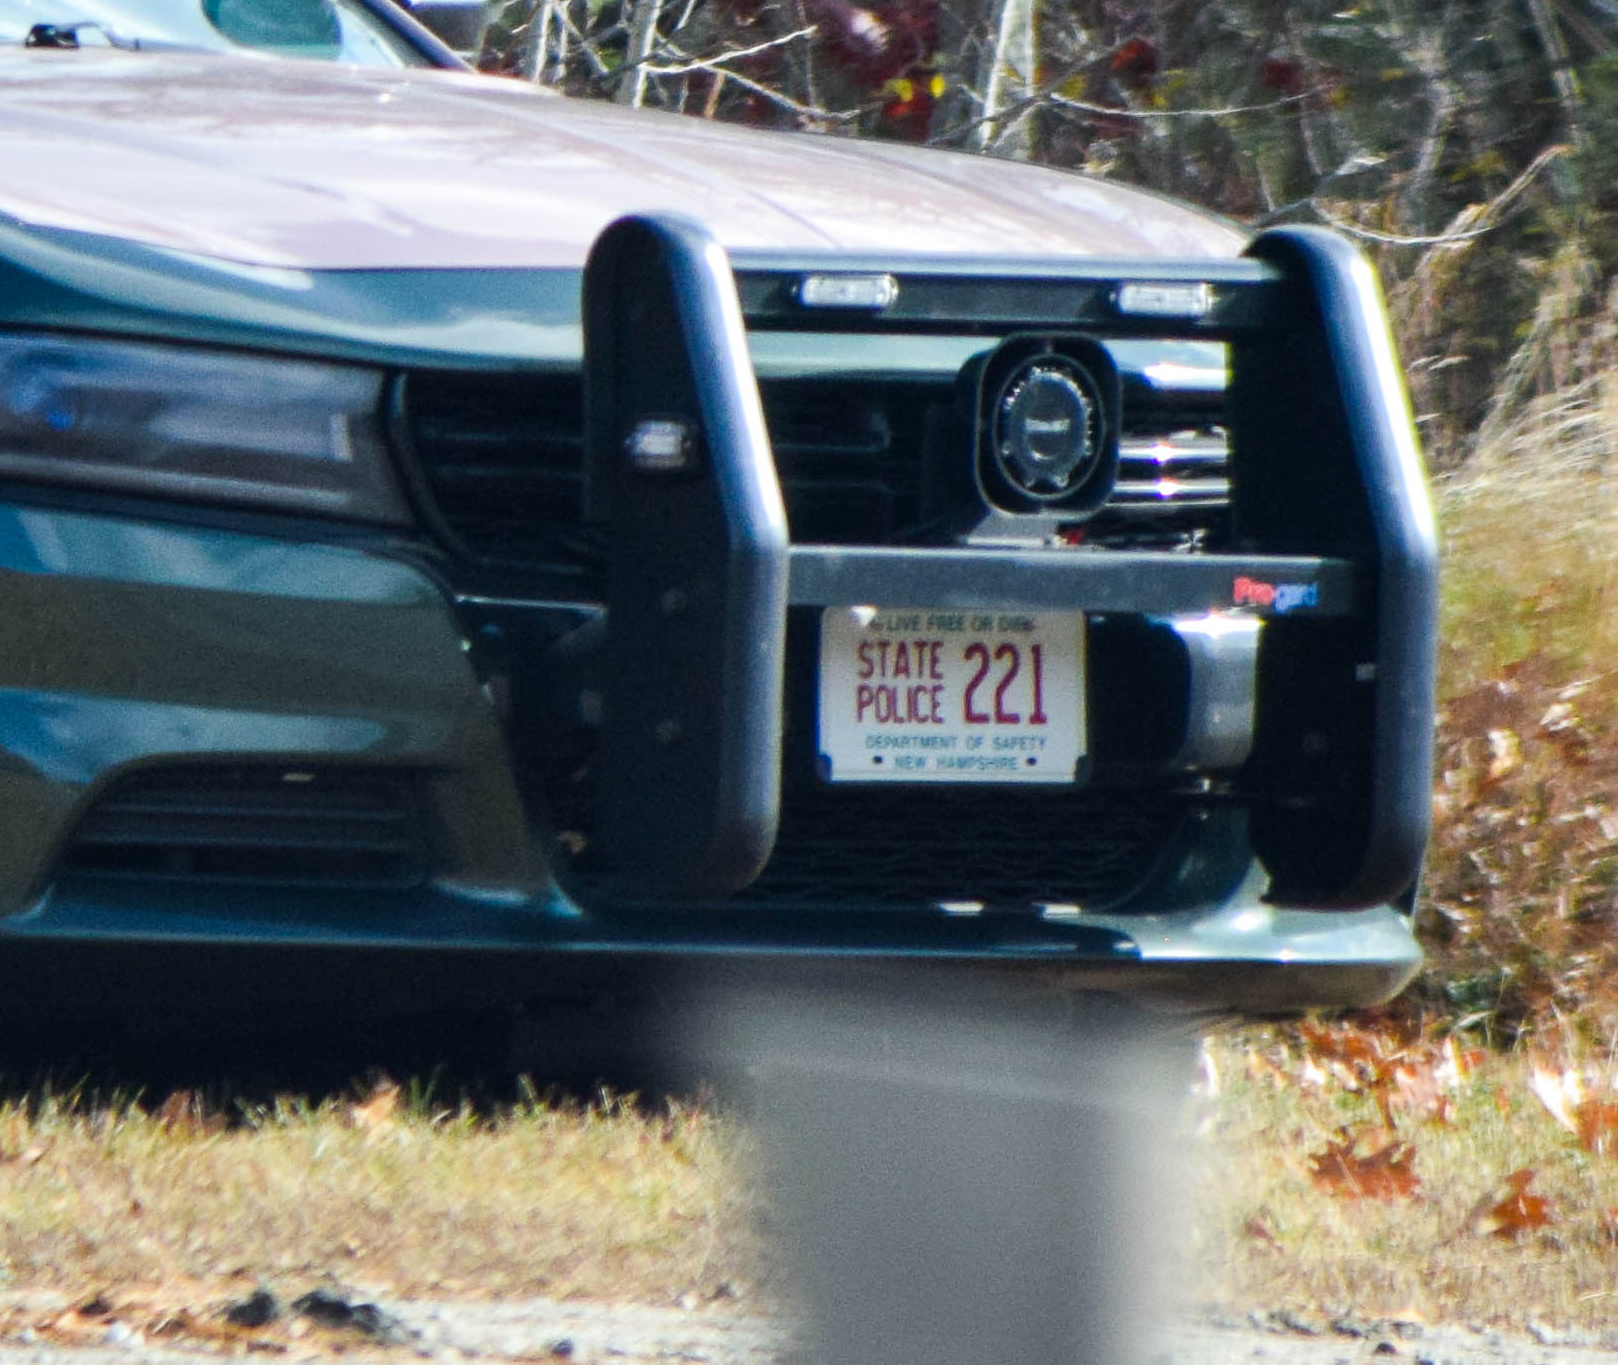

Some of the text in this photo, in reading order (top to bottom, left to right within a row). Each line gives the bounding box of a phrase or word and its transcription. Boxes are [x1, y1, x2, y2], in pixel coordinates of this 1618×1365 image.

[926, 615, 966, 632] FREE
[856, 640, 1047, 725] STATE 221
[856, 684, 945, 724] POLICE
[866, 736, 1047, 752] DEPARTMENT OF SAFETY
[894, 755, 1018, 771] NEW HAMPSHIRE
